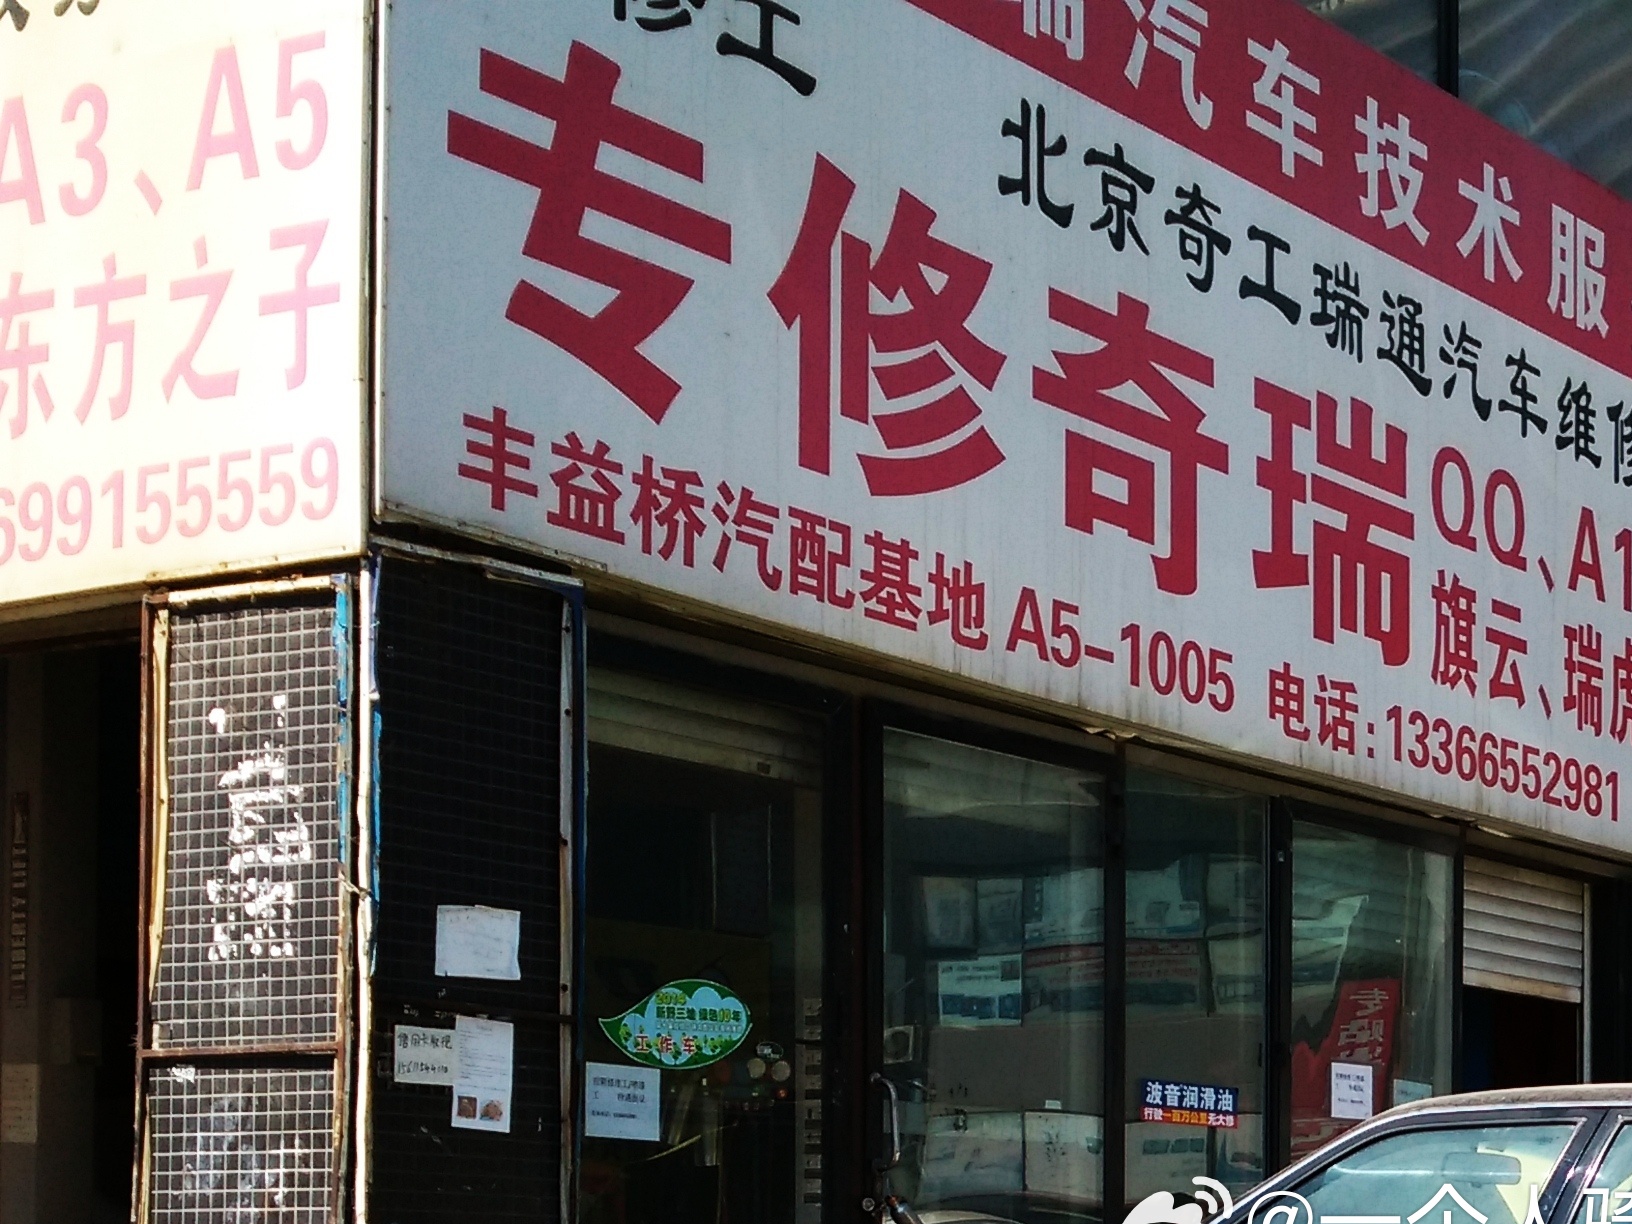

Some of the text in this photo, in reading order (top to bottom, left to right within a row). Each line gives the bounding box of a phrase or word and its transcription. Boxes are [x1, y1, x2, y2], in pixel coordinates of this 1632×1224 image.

[446, 39, 1415, 668] 专修奇瑞
[457, 405, 990, 652] 丰益桥汽配基地
[1005, 585, 1236, 714] A5-1005
[635, 1033, 698, 1054] 工作车
[1145, 1081, 1233, 1112] 波音润滑油
